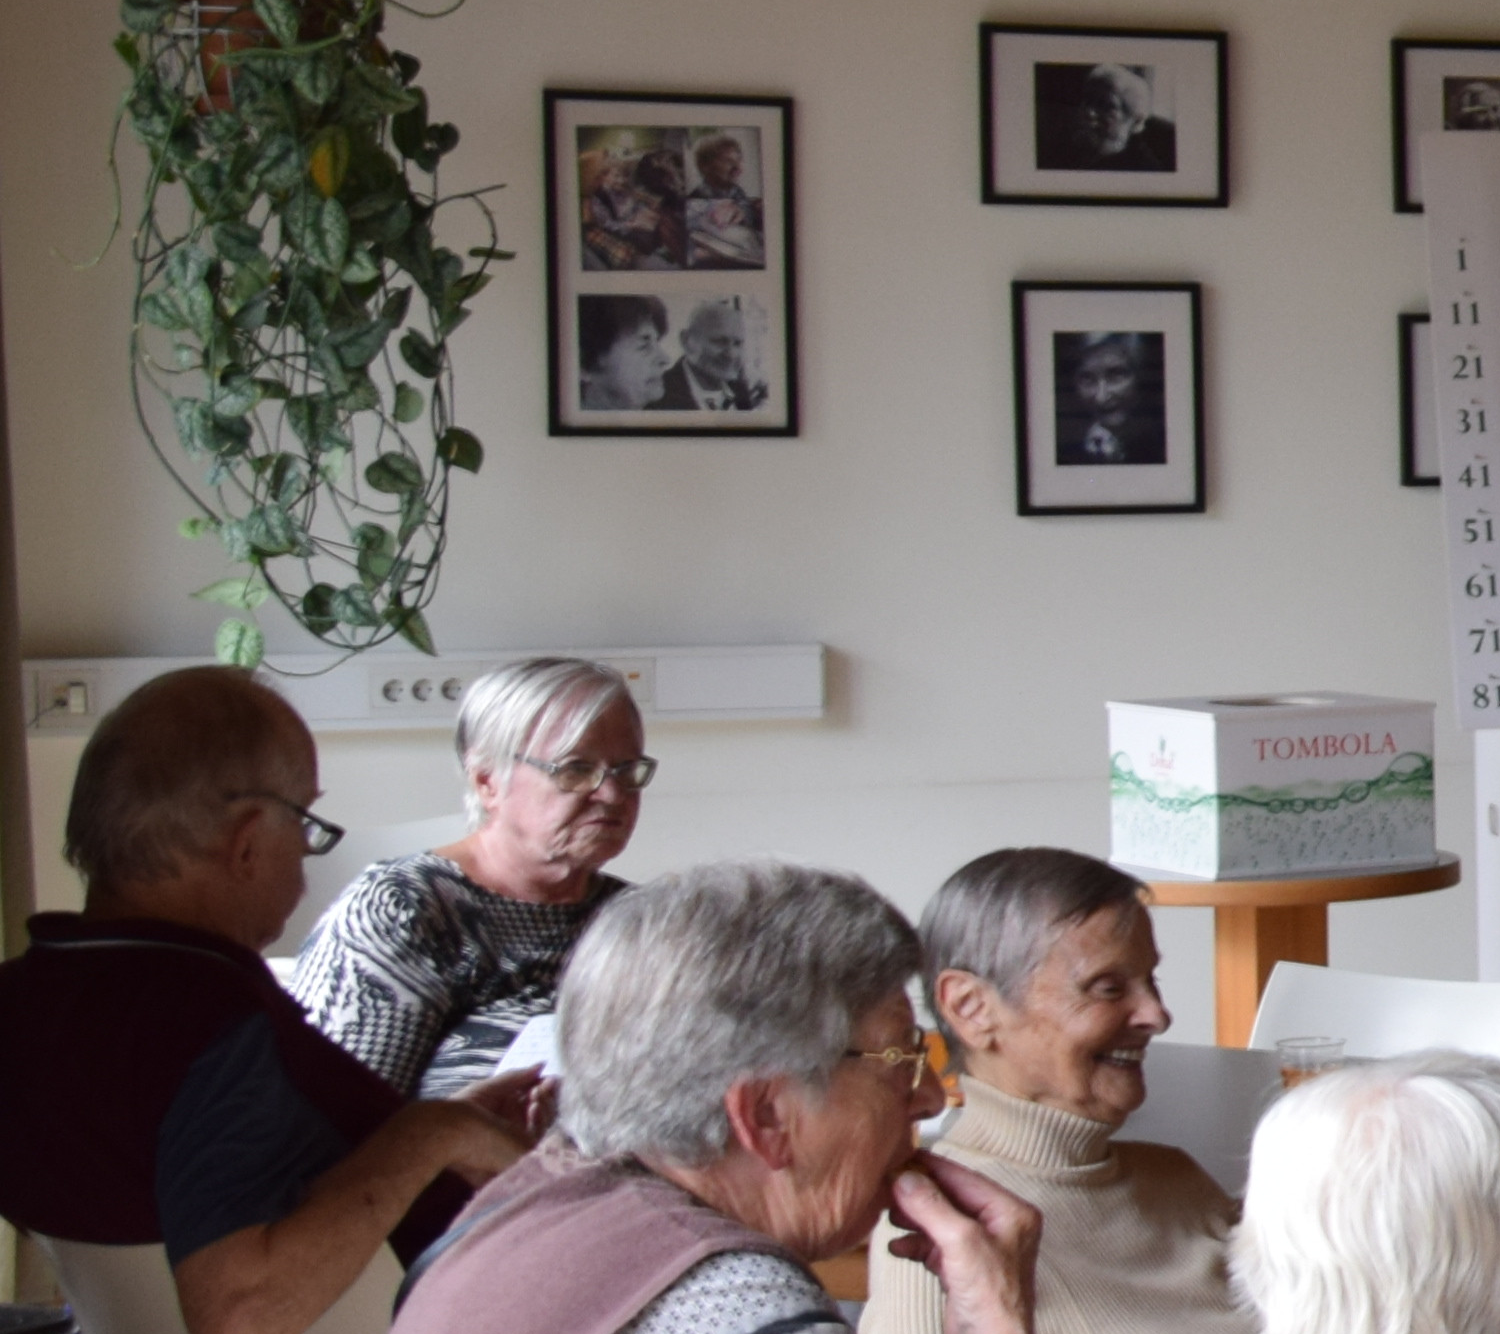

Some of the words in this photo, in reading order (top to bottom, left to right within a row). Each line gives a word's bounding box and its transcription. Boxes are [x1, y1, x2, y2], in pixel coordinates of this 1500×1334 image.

[1456, 248, 1468, 272] 1
[1451, 301, 1480, 326] 11
[1452, 354, 1483, 380] 21
[1458, 408, 1487, 434] 31
[1458, 464, 1491, 488] 41
[1463, 518, 1494, 544] 51
[1464, 573, 1498, 599] 61
[1468, 628, 1500, 654] 71
[1253, 730, 1399, 762] TOMBOLA
